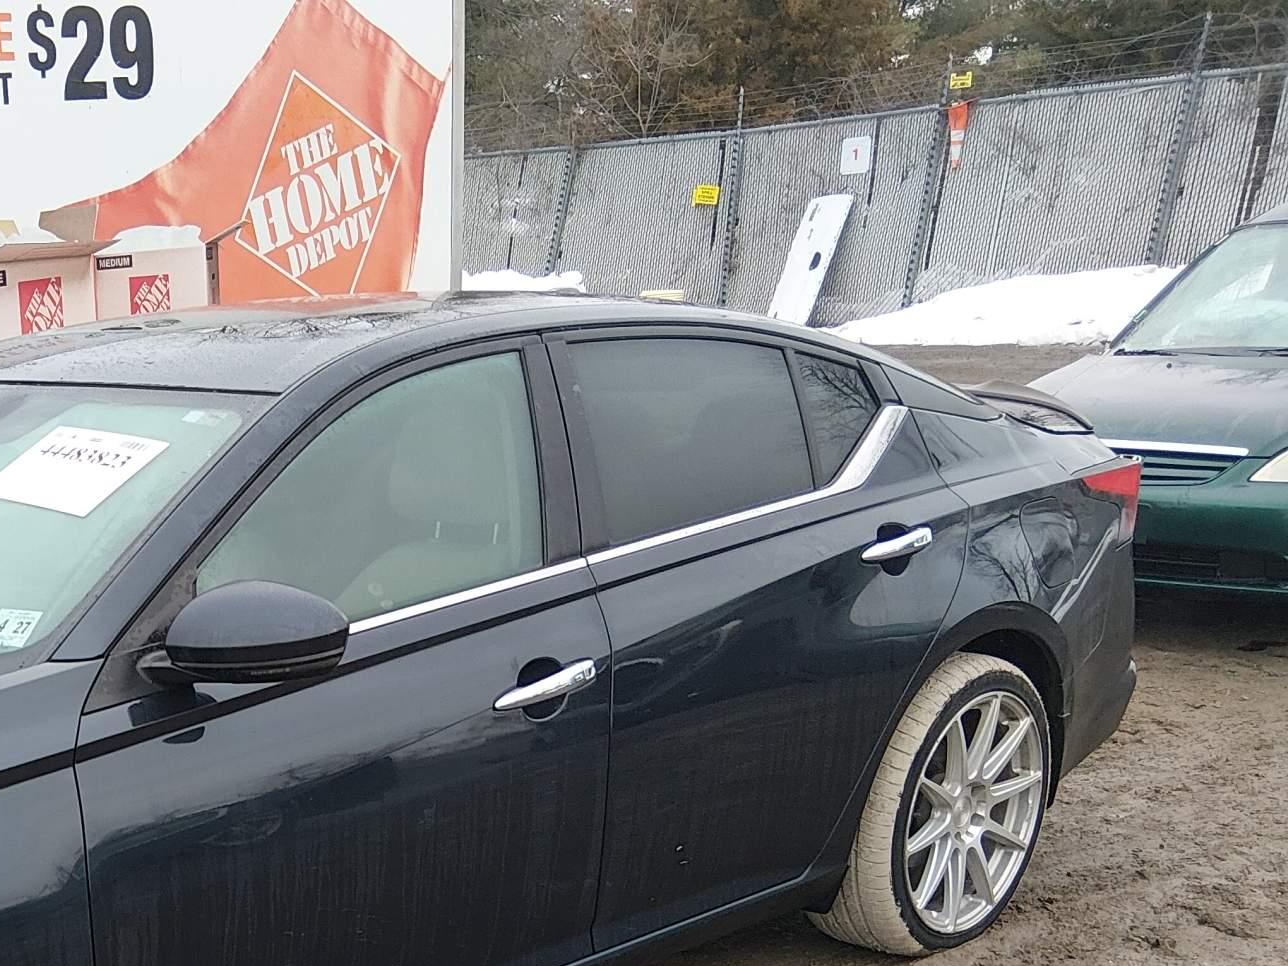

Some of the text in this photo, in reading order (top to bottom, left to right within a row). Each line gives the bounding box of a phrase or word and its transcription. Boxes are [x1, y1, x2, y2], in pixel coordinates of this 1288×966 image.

[27, 4, 154, 101] $29
[280, 123, 338, 176] THE
[852, 148, 859, 160] 1
[248, 138, 390, 255] HOME
[286, 206, 373, 279] DEPOT
[99, 256, 131, 269] MEDIUM
[40, 444, 132, 468] 44483823
[12, 621, 32, 634] 27
